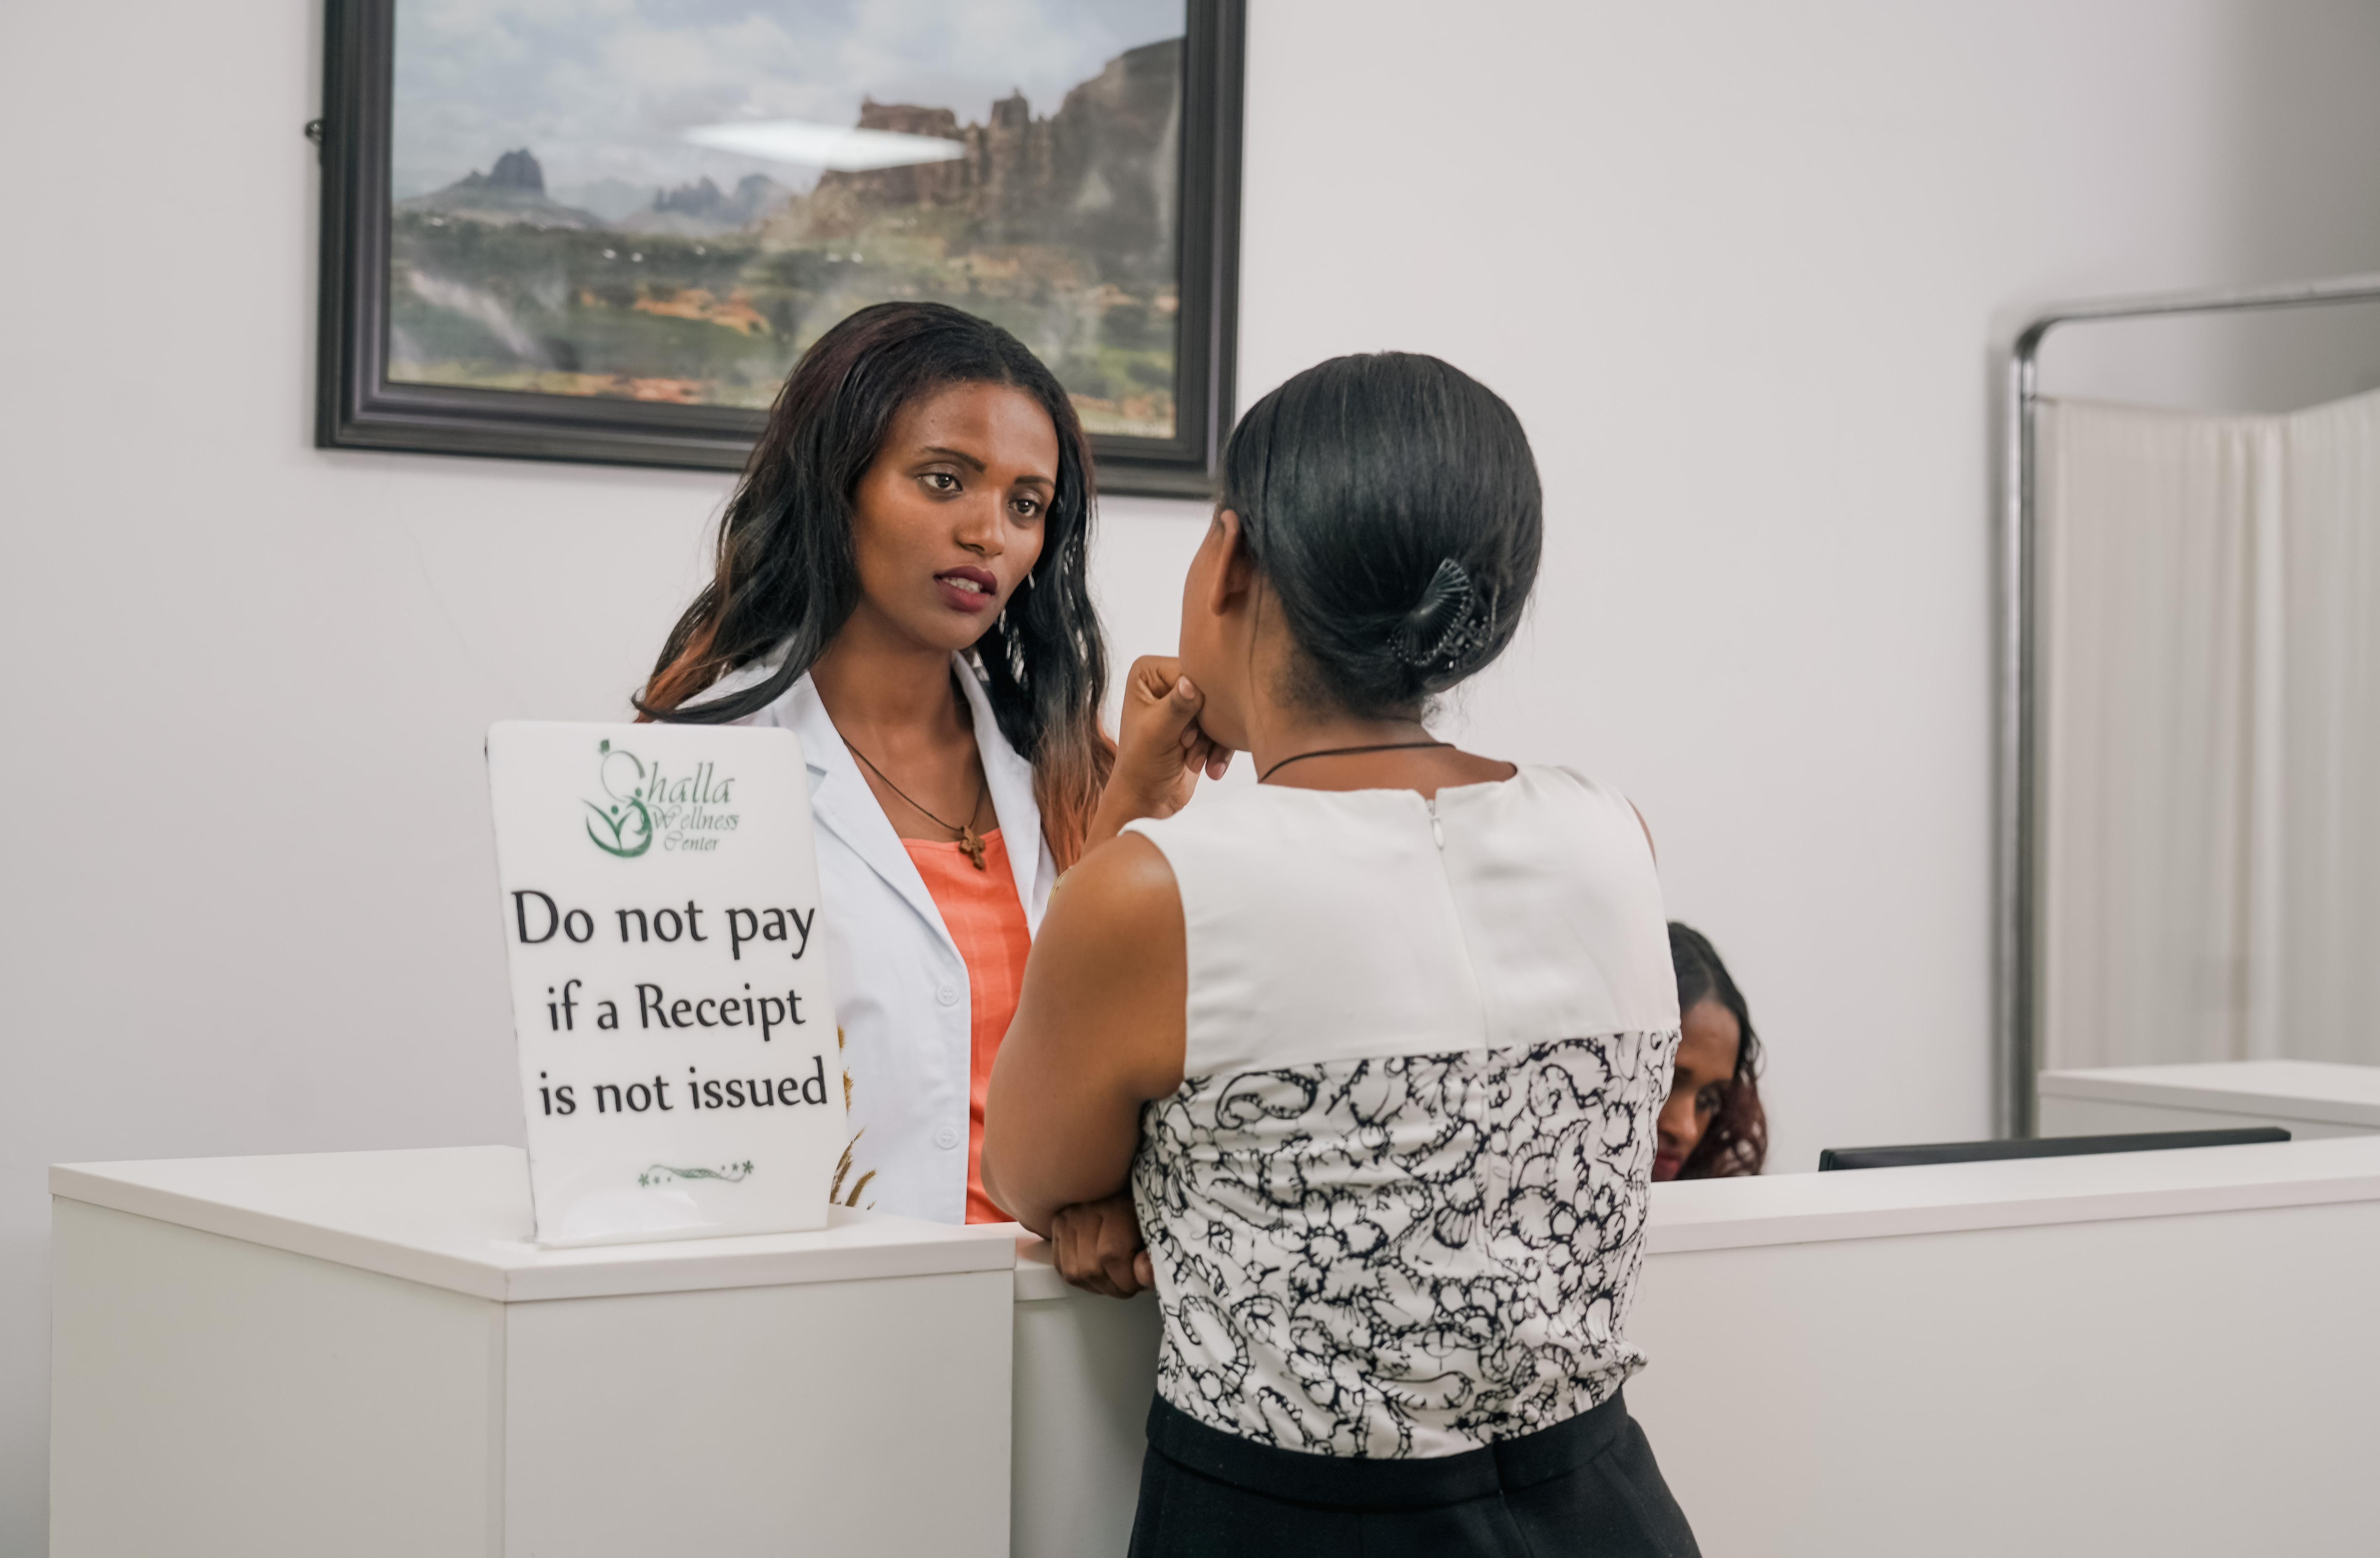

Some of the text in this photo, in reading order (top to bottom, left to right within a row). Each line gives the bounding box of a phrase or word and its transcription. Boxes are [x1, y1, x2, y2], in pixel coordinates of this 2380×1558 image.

[644, 804, 740, 831] Wellness
[663, 830, 720, 852] Center
[511, 890, 815, 960] Do not pay
[547, 979, 806, 1042] if a Receipt
[539, 1055, 828, 1115] is not issued
